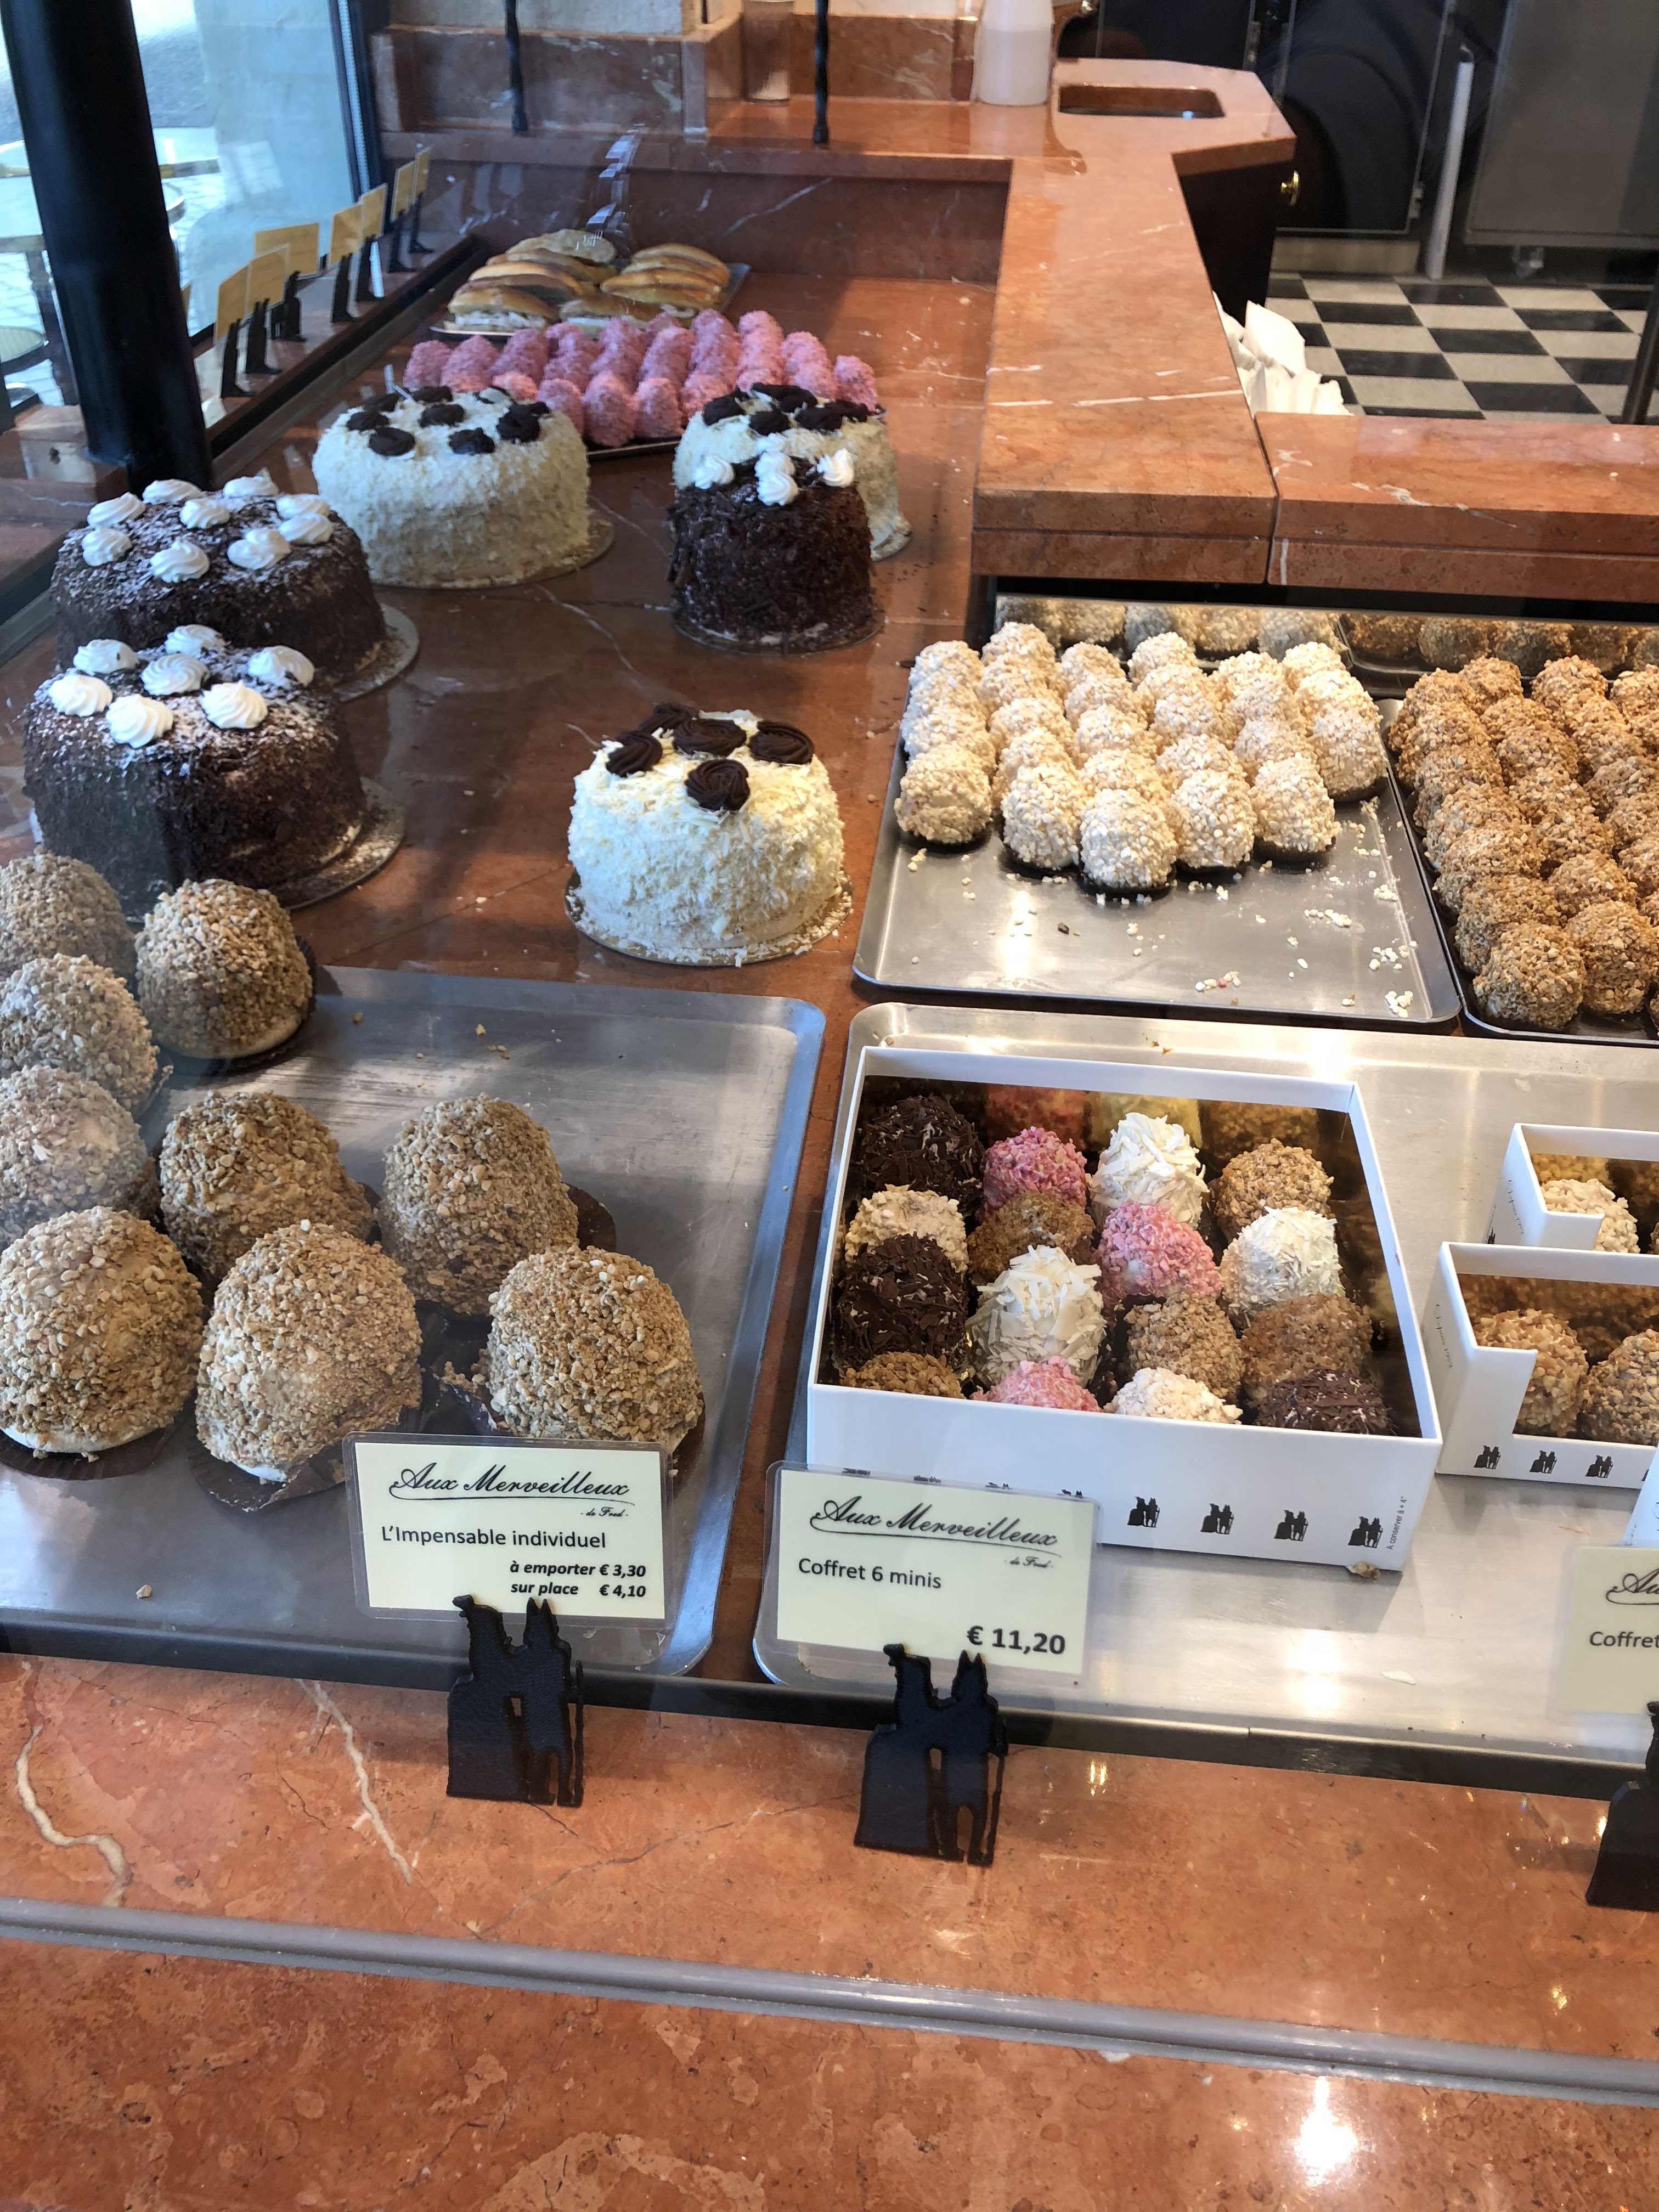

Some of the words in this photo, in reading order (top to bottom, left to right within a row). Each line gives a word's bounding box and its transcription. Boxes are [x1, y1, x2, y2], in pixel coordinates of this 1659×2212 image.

[390, 1462, 459, 1497] Aux
[463, 1464, 630, 1496] Merveilleux
[585, 1508, 597, 1516] de
[599, 1506, 626, 1517] Fred
[810, 1496, 881, 1534] Aux
[885, 1502, 1058, 1547] Merveilleux
[512, 1530, 606, 1548] individuel
[510, 1560, 520, 1573] à
[523, 1564, 596, 1578] emporter
[599, 1564, 610, 1576] €
[612, 1564, 646, 1579] 3,30
[798, 1558, 866, 1581] Coffret
[872, 1566, 883, 1582] 6
[889, 1569, 942, 1589] minis
[511, 1583, 535, 1593] sur
[538, 1581, 579, 1596] place
[599, 1584, 610, 1596] €
[612, 1584, 646, 1599] 4,10
[966, 1625, 984, 1646] €
[991, 1628, 1066, 1655] 11,20
